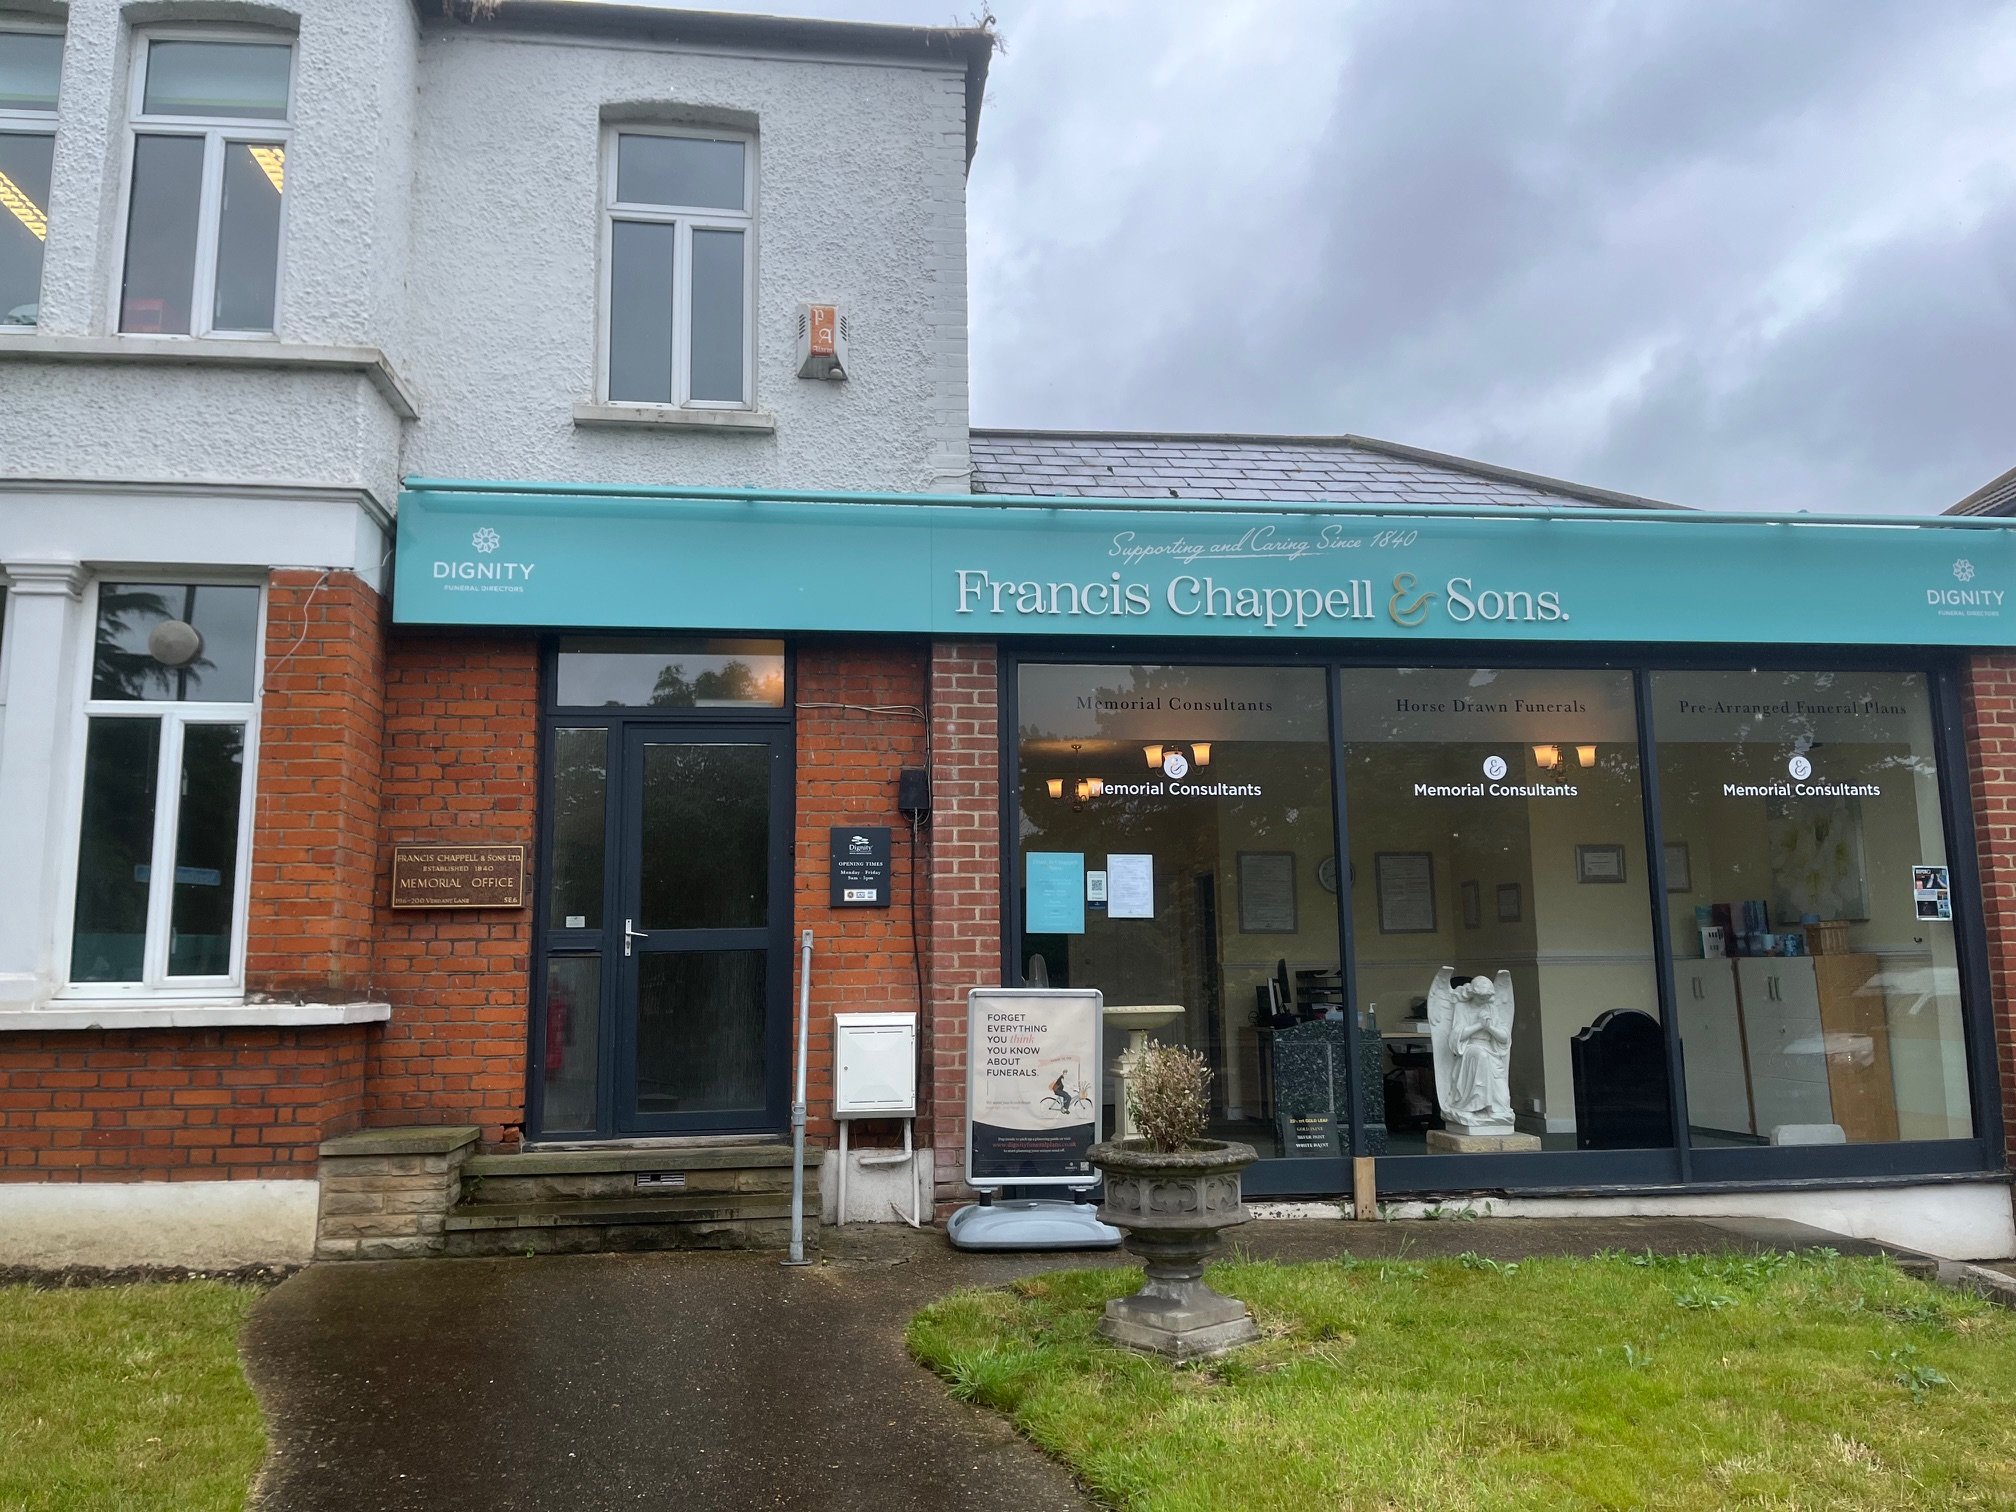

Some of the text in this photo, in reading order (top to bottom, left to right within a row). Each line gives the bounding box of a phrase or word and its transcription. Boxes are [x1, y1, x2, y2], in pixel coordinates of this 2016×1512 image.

[1109, 524, 1418, 565] Supporting and Caring Since 1840
[433, 561, 535, 580] DIGNITY
[444, 584, 524, 593] FUNERAL DIRECTORS
[955, 569, 1571, 627] Francis Chappell & Sons.
[1927, 589, 2005, 606] DIGNITY
[1077, 696, 1273, 712] Memorial Consultants
[1396, 699, 1587, 713] Horse Drawn Funerals
[1679, 700, 1907, 718] Pre-Arranged Funeral Plans
[1091, 781, 1262, 797] Memorial Consultants
[1414, 783, 1578, 797] Memorial Consultants
[1723, 783, 1881, 796] Memorial Consultants
[398, 854, 434, 862] FRANCIS
[437, 854, 478, 862] CHAPPELL
[488, 854, 506, 862] SONS
[508, 854, 521, 862] LTD
[400, 878, 514, 888] MEMORIAL OFFICE
[987, 1025, 1048, 1033] EVERYTHING
[987, 1035, 1035, 1044] YOU think
[987, 1058, 1020, 1066] ABOUT
